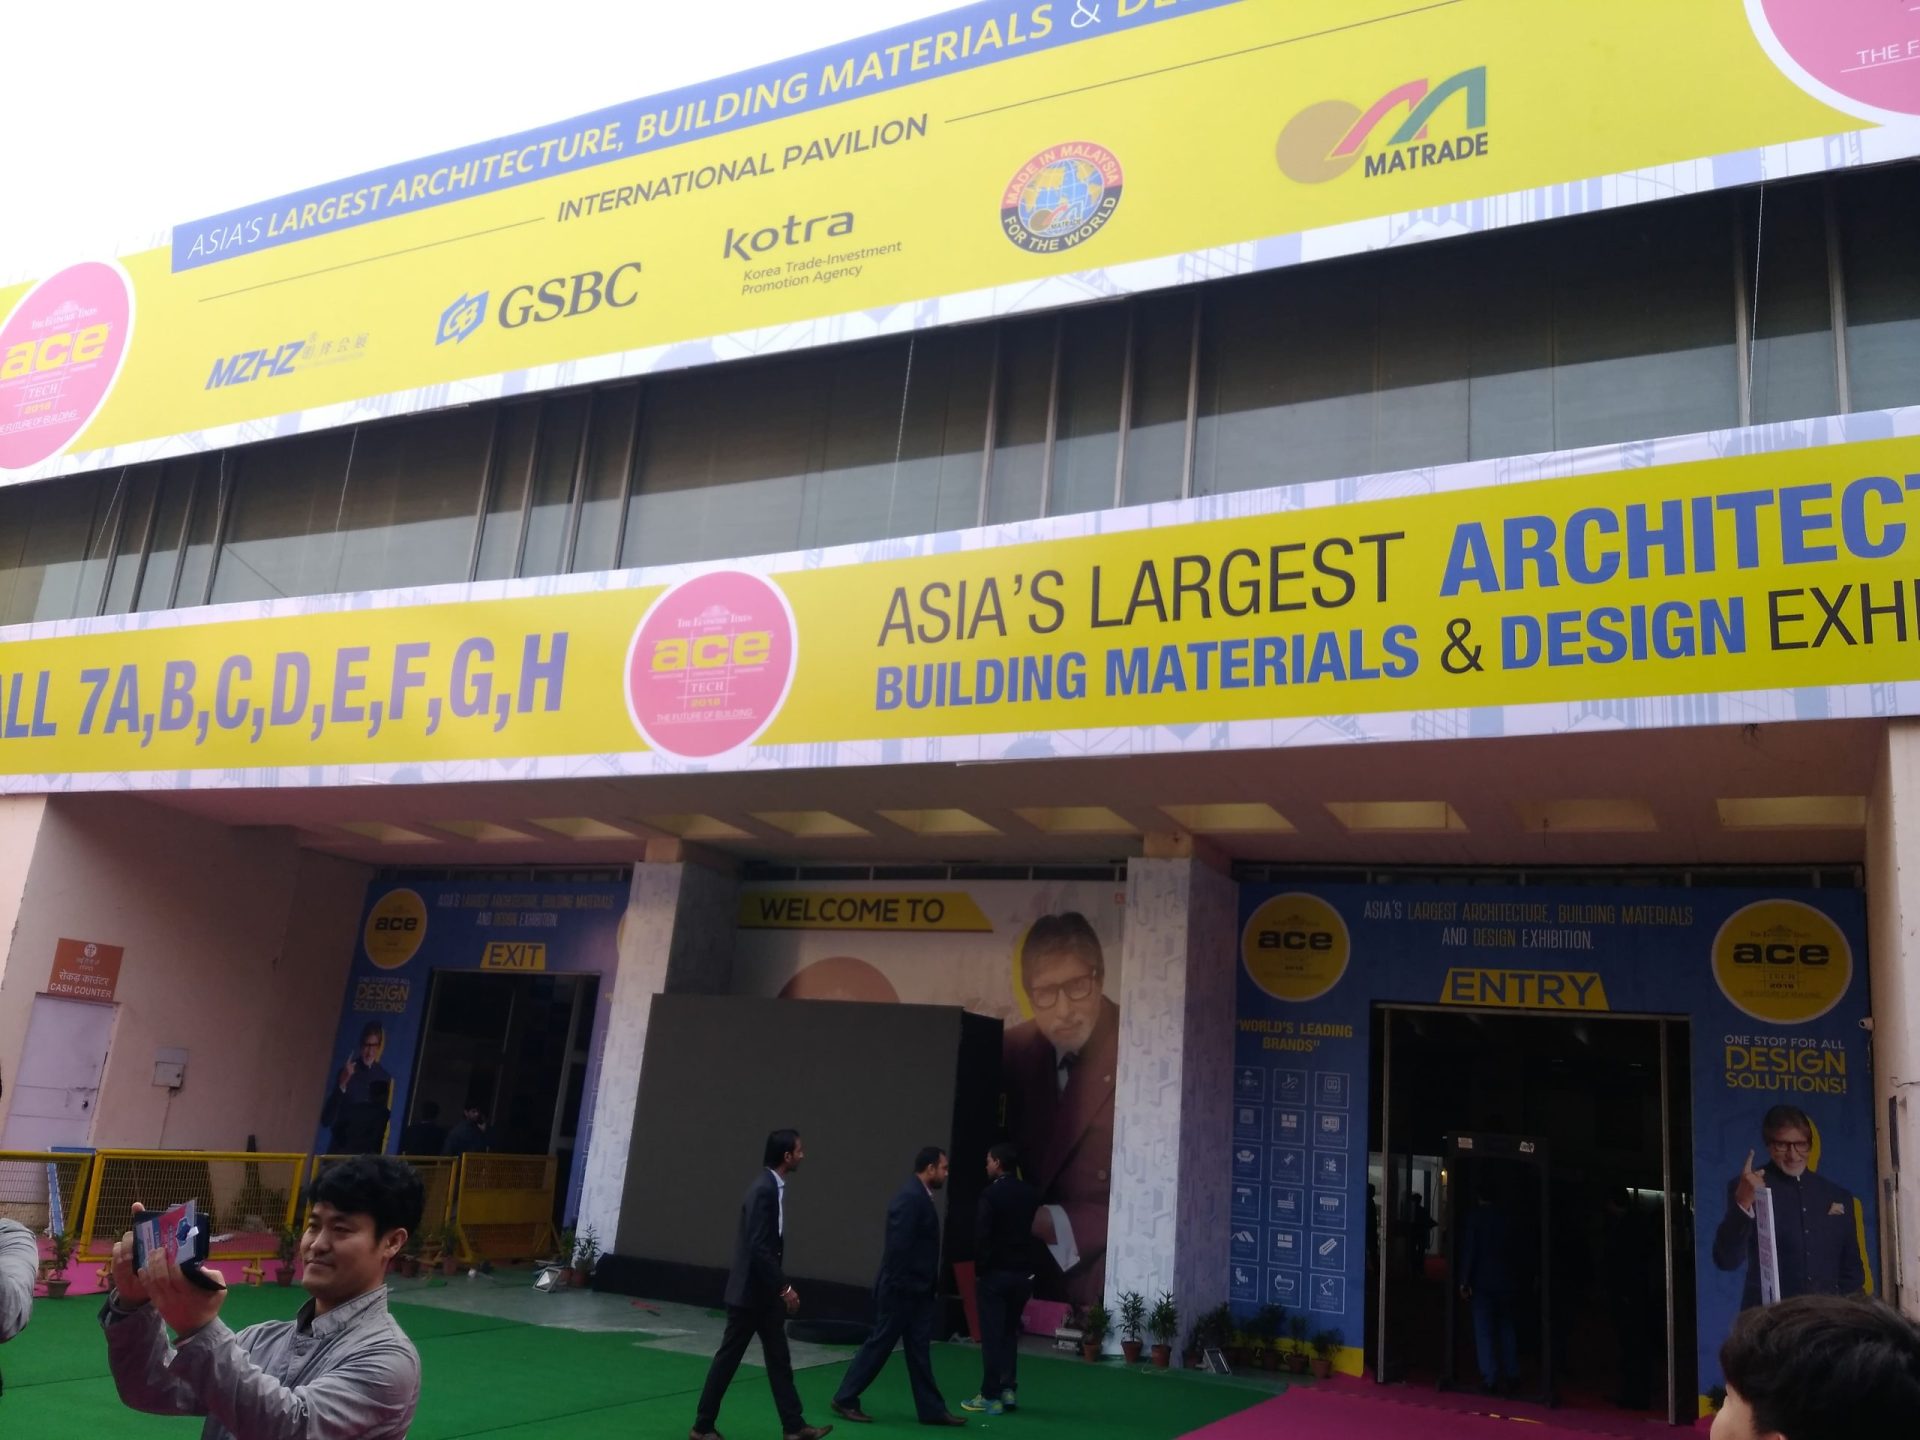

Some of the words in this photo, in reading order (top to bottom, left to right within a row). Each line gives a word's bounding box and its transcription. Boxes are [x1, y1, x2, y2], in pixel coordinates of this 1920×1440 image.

[1856, 44, 1900, 64] THE
[187, 217, 263, 260] ASIA'S
[266, 183, 387, 238] LARGEST
[388, 121, 625, 205] ARCHITECTURE,
[637, 74, 807, 141] BUILDING
[819, 3, 1053, 97] MATERIALS
[1070, 0, 1100, 28] &
[558, 149, 774, 222] INTERNATIONAL
[782, 114, 928, 171] PAVILION
[1364, 131, 1489, 178] MATRADE
[1006, 164, 1037, 205] MADE
[1040, 151, 1057, 166] IN
[1061, 144, 1120, 184] MALAYSIA
[723, 212, 855, 261] kotra
[1004, 216, 1027, 244] FOR
[1029, 237, 1060, 251] THE
[1064, 197, 1116, 246] WORLD
[744, 266, 781, 281] Korea
[786, 241, 903, 273] Trade-Investment
[498, 262, 642, 329] GSBC
[741, 275, 809, 296] Promotion
[813, 265, 863, 284] Agency
[0, 323, 109, 379] ace
[204, 340, 305, 391] MZHZ
[877, 570, 1065, 647] ASIA'S
[1090, 531, 1405, 629] LARGEST
[652, 631, 770, 672] ace
[875, 651, 1087, 711] BUILDING
[1106, 624, 1419, 696] MATERIALS
[1440, 617, 1484, 674] &
[1501, 596, 1746, 670] DESIGN
[690, 681, 724, 693] TECH
[0, 670, 57, 738] LL
[375, 917, 418, 931] ace
[759, 897, 900, 923] WELCOME
[907, 898, 945, 924] TO
[1363, 900, 1402, 920] ASIA'S
[1407, 902, 1457, 921] LARGEST
[1558, 904, 1615, 924] BUILDING
[1621, 905, 1694, 925] MATERIALS
[1258, 931, 1333, 950] ace
[1442, 927, 1467, 945] AND
[1473, 928, 1516, 947] DESIGN
[488, 945, 542, 967] EXIT
[1733, 943, 1830, 965] ace
[50, 982, 73, 992] CASH
[74, 986, 112, 998] COUNTER
[1451, 971, 1597, 1006] ENTRY
[1300, 1023, 1352, 1038] LEADING
[1724, 1034, 1750, 1045] ONE
[1754, 1036, 1787, 1047] STOP
[1791, 1037, 1817, 1048] FOR
[1821, 1039, 1845, 1050] ALL
[1726, 1046, 1847, 1075] DESIGN
[1725, 1072, 1847, 1094] SOLUTIONS!
